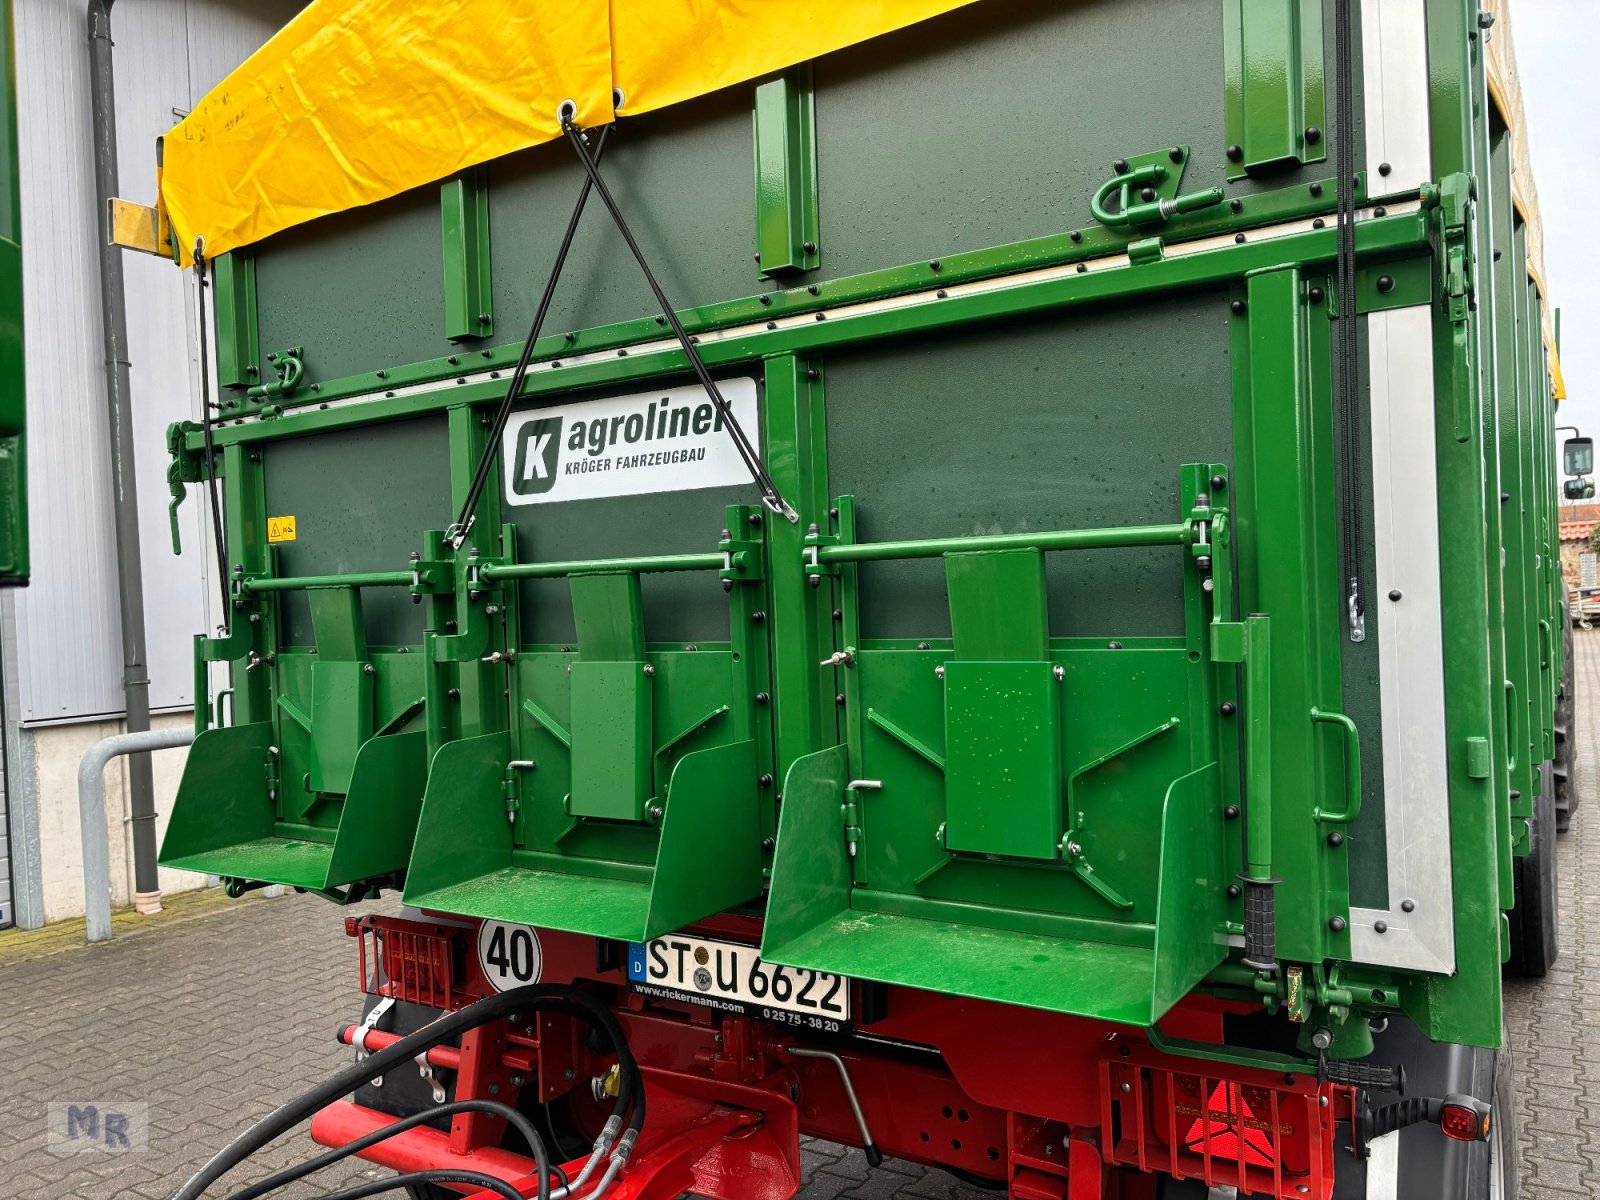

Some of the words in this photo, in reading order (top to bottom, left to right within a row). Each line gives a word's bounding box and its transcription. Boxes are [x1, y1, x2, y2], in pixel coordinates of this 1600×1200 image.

[567, 397, 732, 457] agroliner
[522, 433, 552, 481] K
[565, 457, 611, 475] KRÖGER
[616, 447, 706, 470] FAHRZEUGBAU
[486, 925, 534, 982] 40
[634, 961, 642, 973] D
[649, 940, 691, 983] ST
[716, 949, 738, 994] U
[748, 956, 842, 1013] 6622
[635, 984, 745, 1014] www.rickermann.com
[824, 1020, 839, 1032] 20
